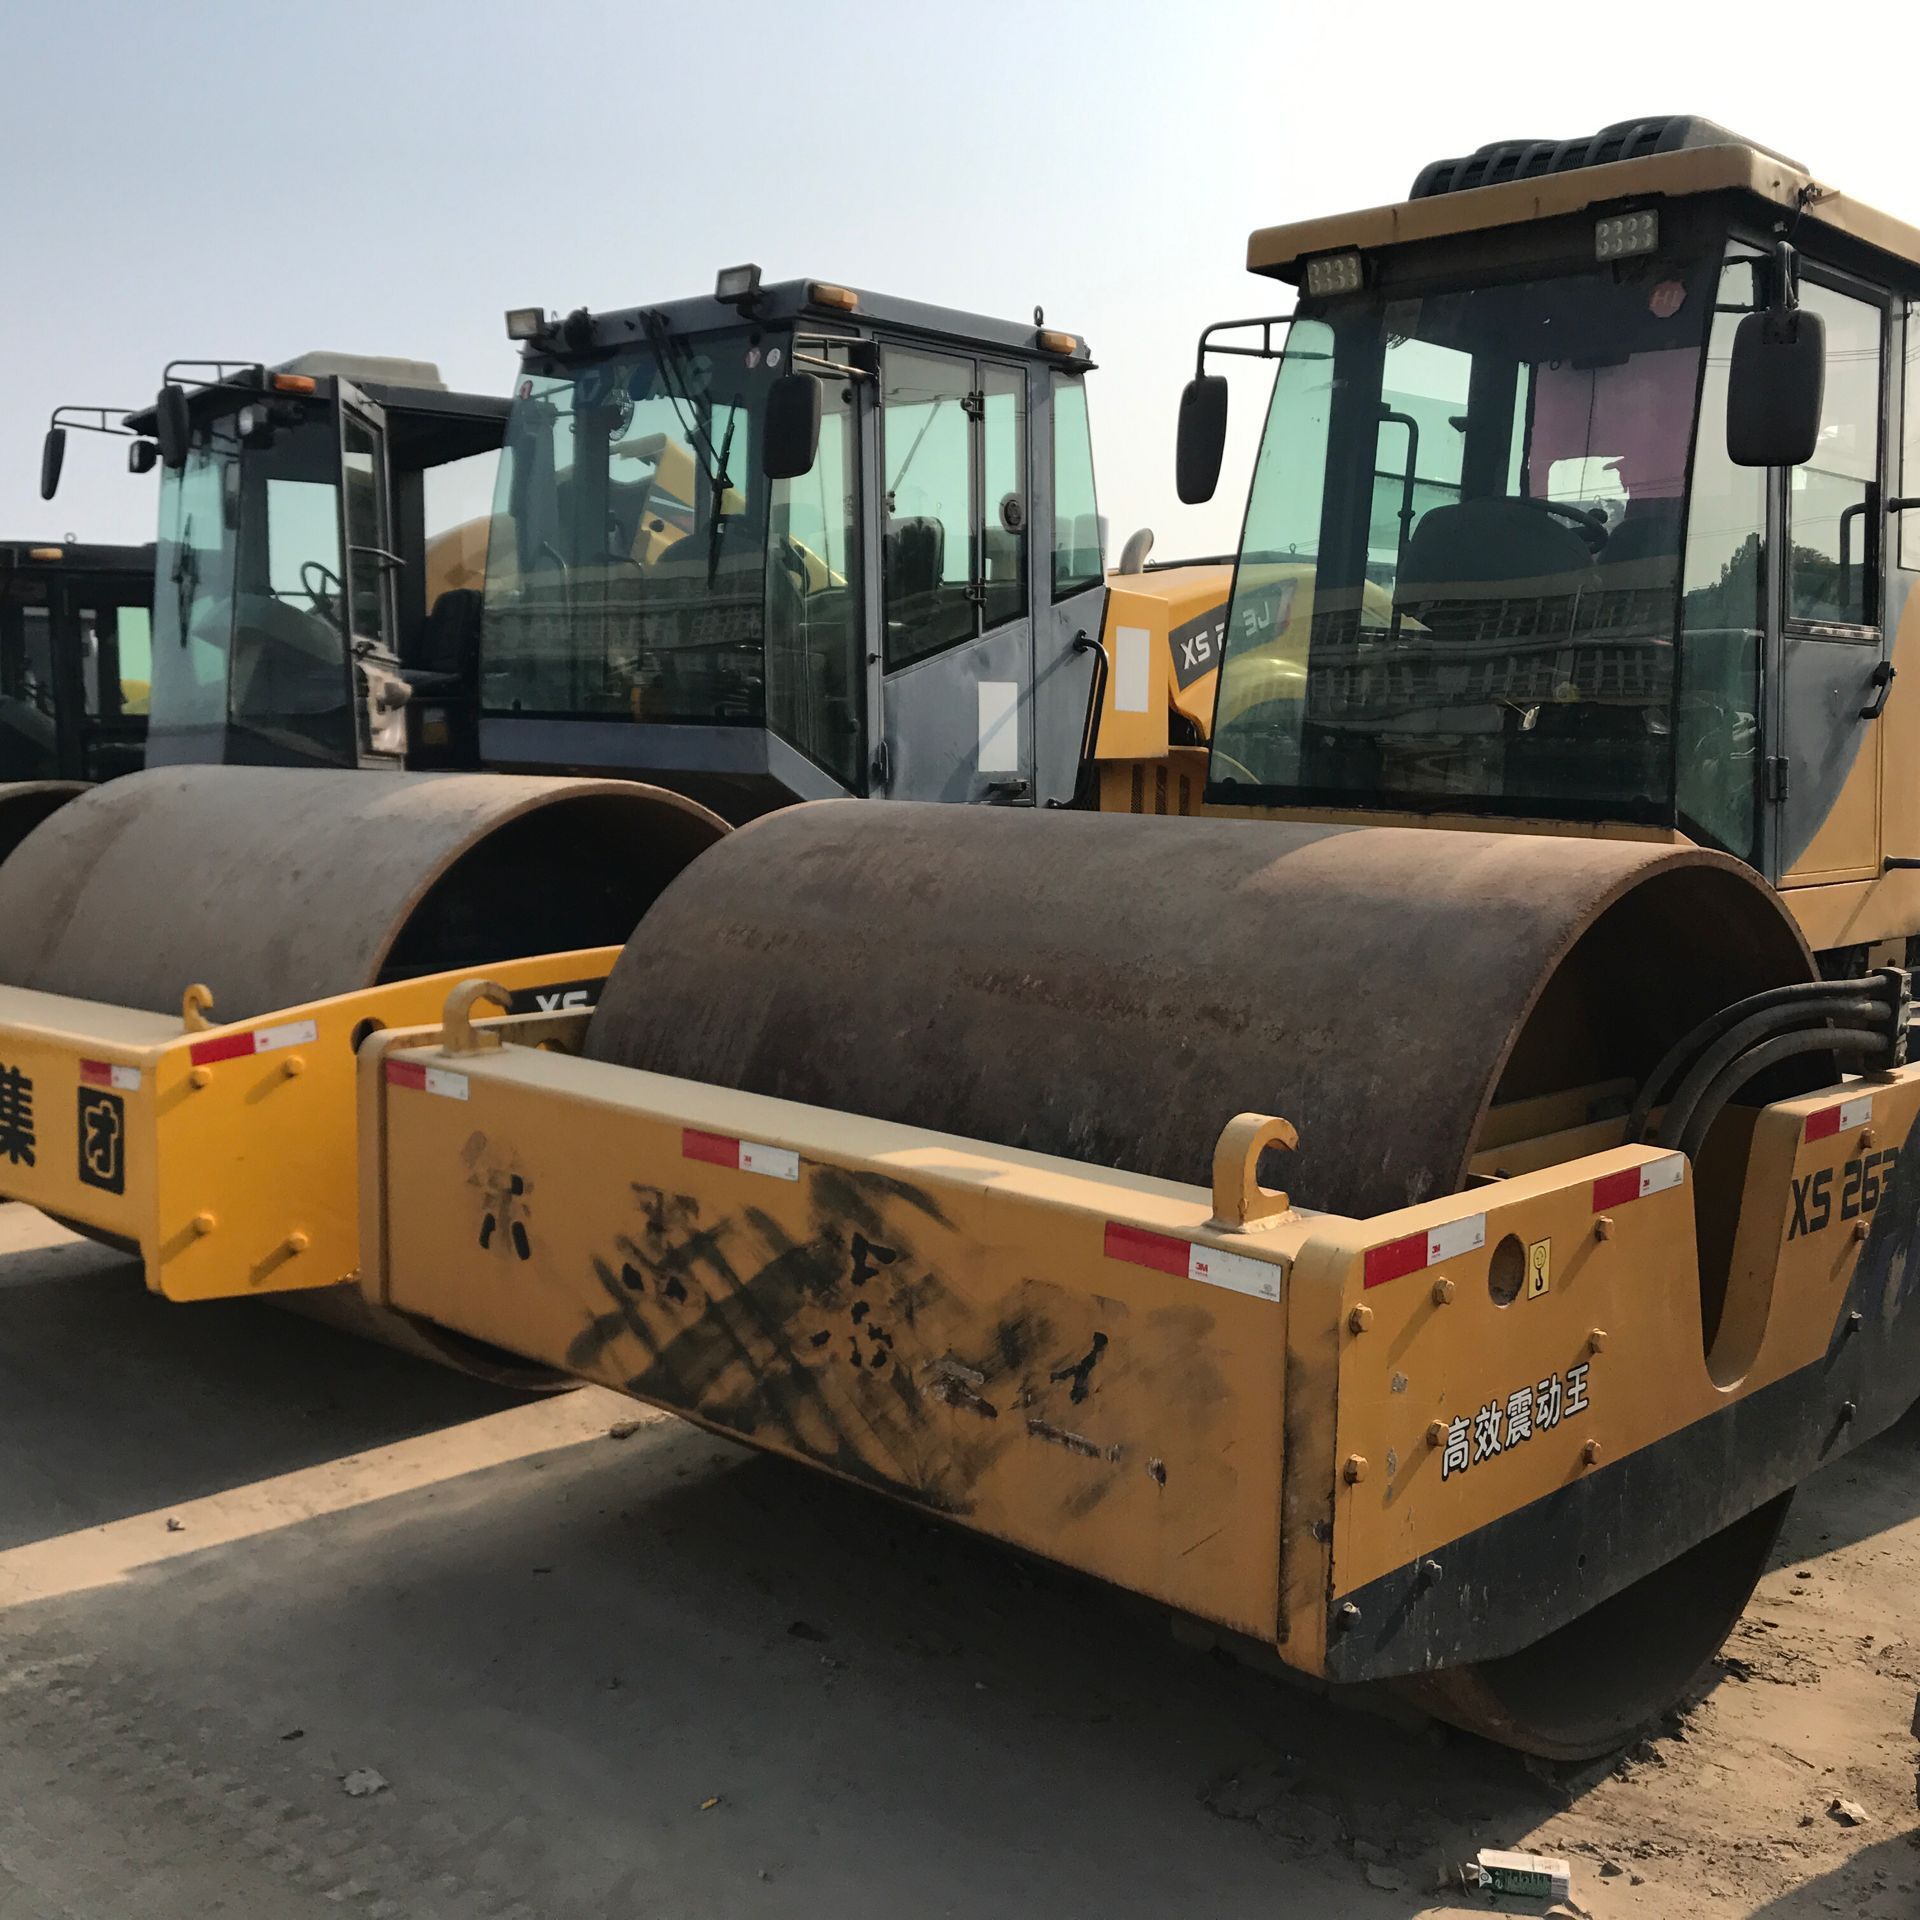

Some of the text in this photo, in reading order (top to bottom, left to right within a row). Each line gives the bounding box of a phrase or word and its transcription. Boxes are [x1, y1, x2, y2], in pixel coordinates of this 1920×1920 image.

[1179, 630, 1211, 670] XS
[1787, 1167, 1834, 1241] XS
[1195, 1261, 1208, 1272] 3M
[1442, 1362, 1590, 1482] 高效震动王
